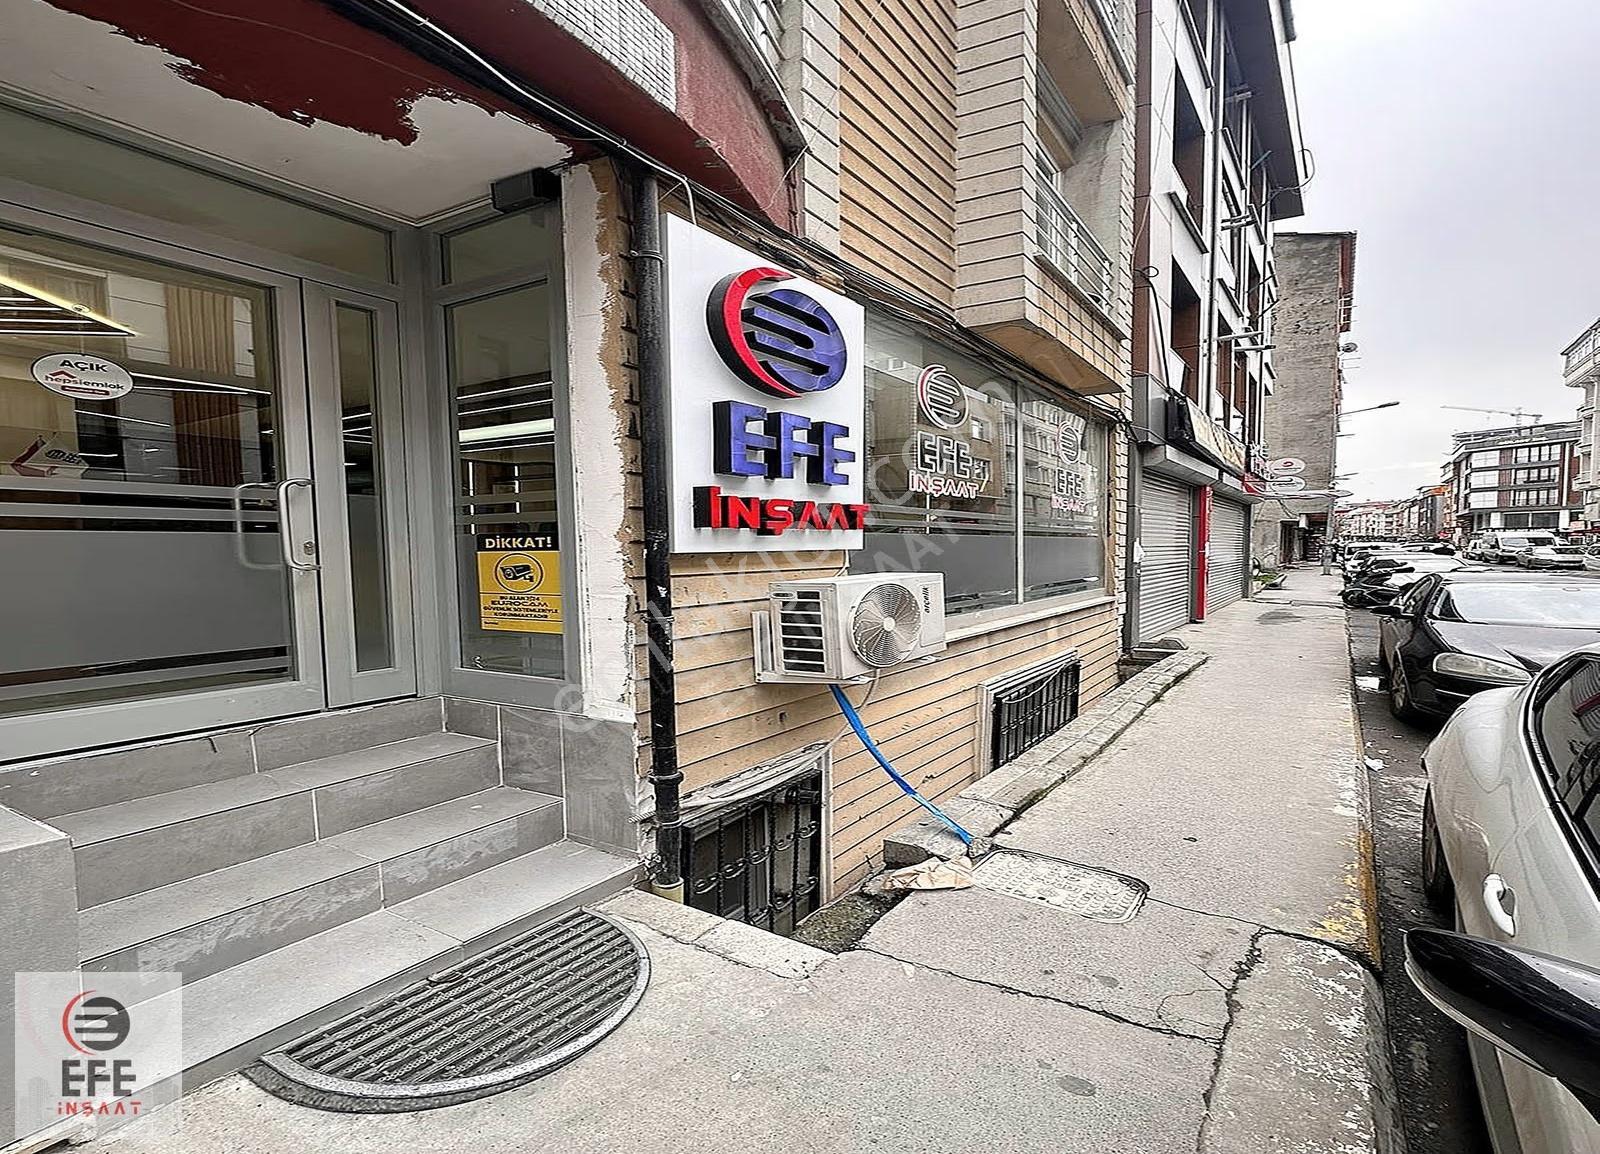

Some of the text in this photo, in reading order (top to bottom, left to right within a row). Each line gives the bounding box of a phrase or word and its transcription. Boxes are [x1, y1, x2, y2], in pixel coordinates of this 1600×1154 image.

[60, 359, 108, 373] AÇIK
[713, 400, 856, 486] EFE
[917, 430, 973, 479] EFE
[909, 469, 980, 499] İNŞAAT
[1054, 467, 1084, 498] EFE
[693, 485, 871, 536] İNŞAAT
[485, 535, 552, 549] DİKKAT!
[490, 600, 549, 608] EUROCAM
